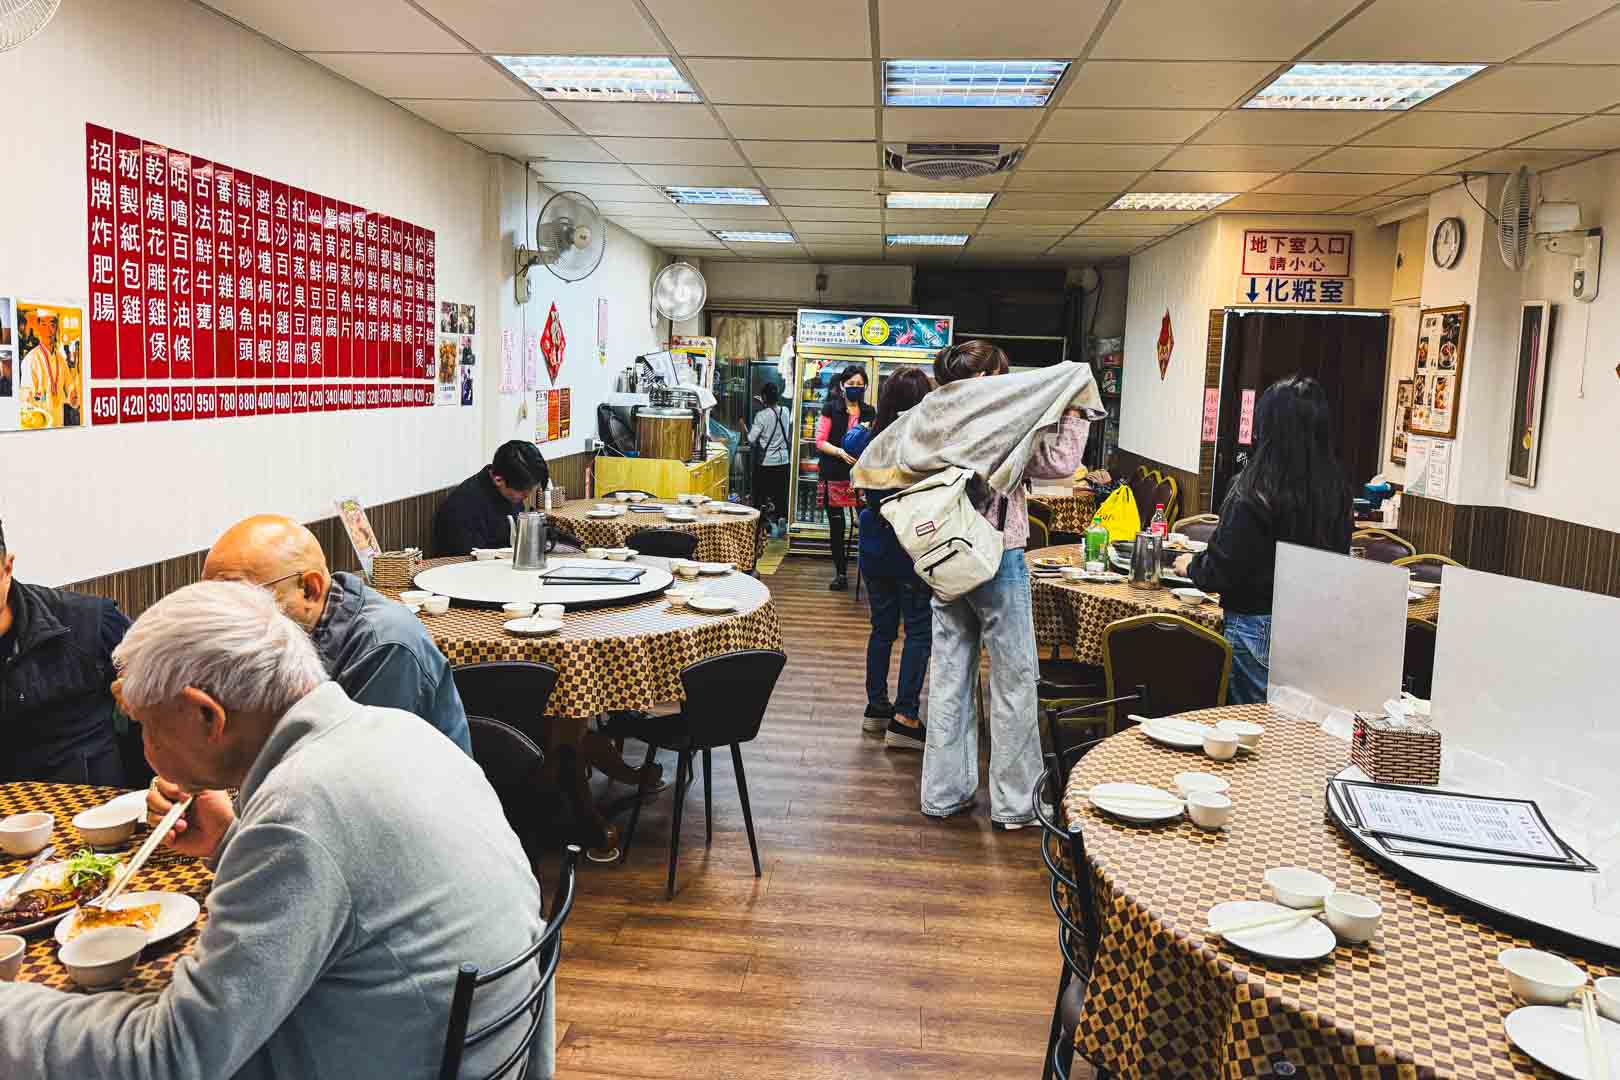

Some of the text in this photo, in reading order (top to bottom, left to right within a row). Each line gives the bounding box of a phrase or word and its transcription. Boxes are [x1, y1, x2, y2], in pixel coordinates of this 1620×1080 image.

[90, 139, 114, 322] 招牌炸肥腸
[118, 150, 142, 325] 秘製紙包雞
[194, 174, 212, 330] 古法鮮牛甕
[216, 176, 234, 331] 蕃茄牛雜鍋
[1250, 235, 1345, 255] 地下室入口
[146, 155, 167, 362] 乾燒花雕雞煲
[170, 166, 191, 362] 咕嚕百花油條
[1269, 257, 1326, 272] 請小心
[236, 183, 254, 362] 蒜子砂鍋魚頭
[256, 188, 272, 364] 避風塘焗中蝦
[292, 200, 306, 365] 紅油蒸臭豆腐
[1265, 278, 1344, 303] 化粧室
[94, 396, 116, 417] 450
[122, 395, 144, 416] 420
[148, 393, 169, 414] 390
[174, 393, 192, 412] 350
[196, 393, 214, 412] 950
[219, 392, 235, 410] 780
[238, 393, 254, 410] 880
[258, 391, 272, 409] 400
[276, 392, 290, 409] 400
[294, 390, 306, 408] 220
[310, 390, 322, 407] 420
[325, 390, 337, 406] 340
[340, 390, 352, 404] 400
[367, 390, 378, 404] 320
